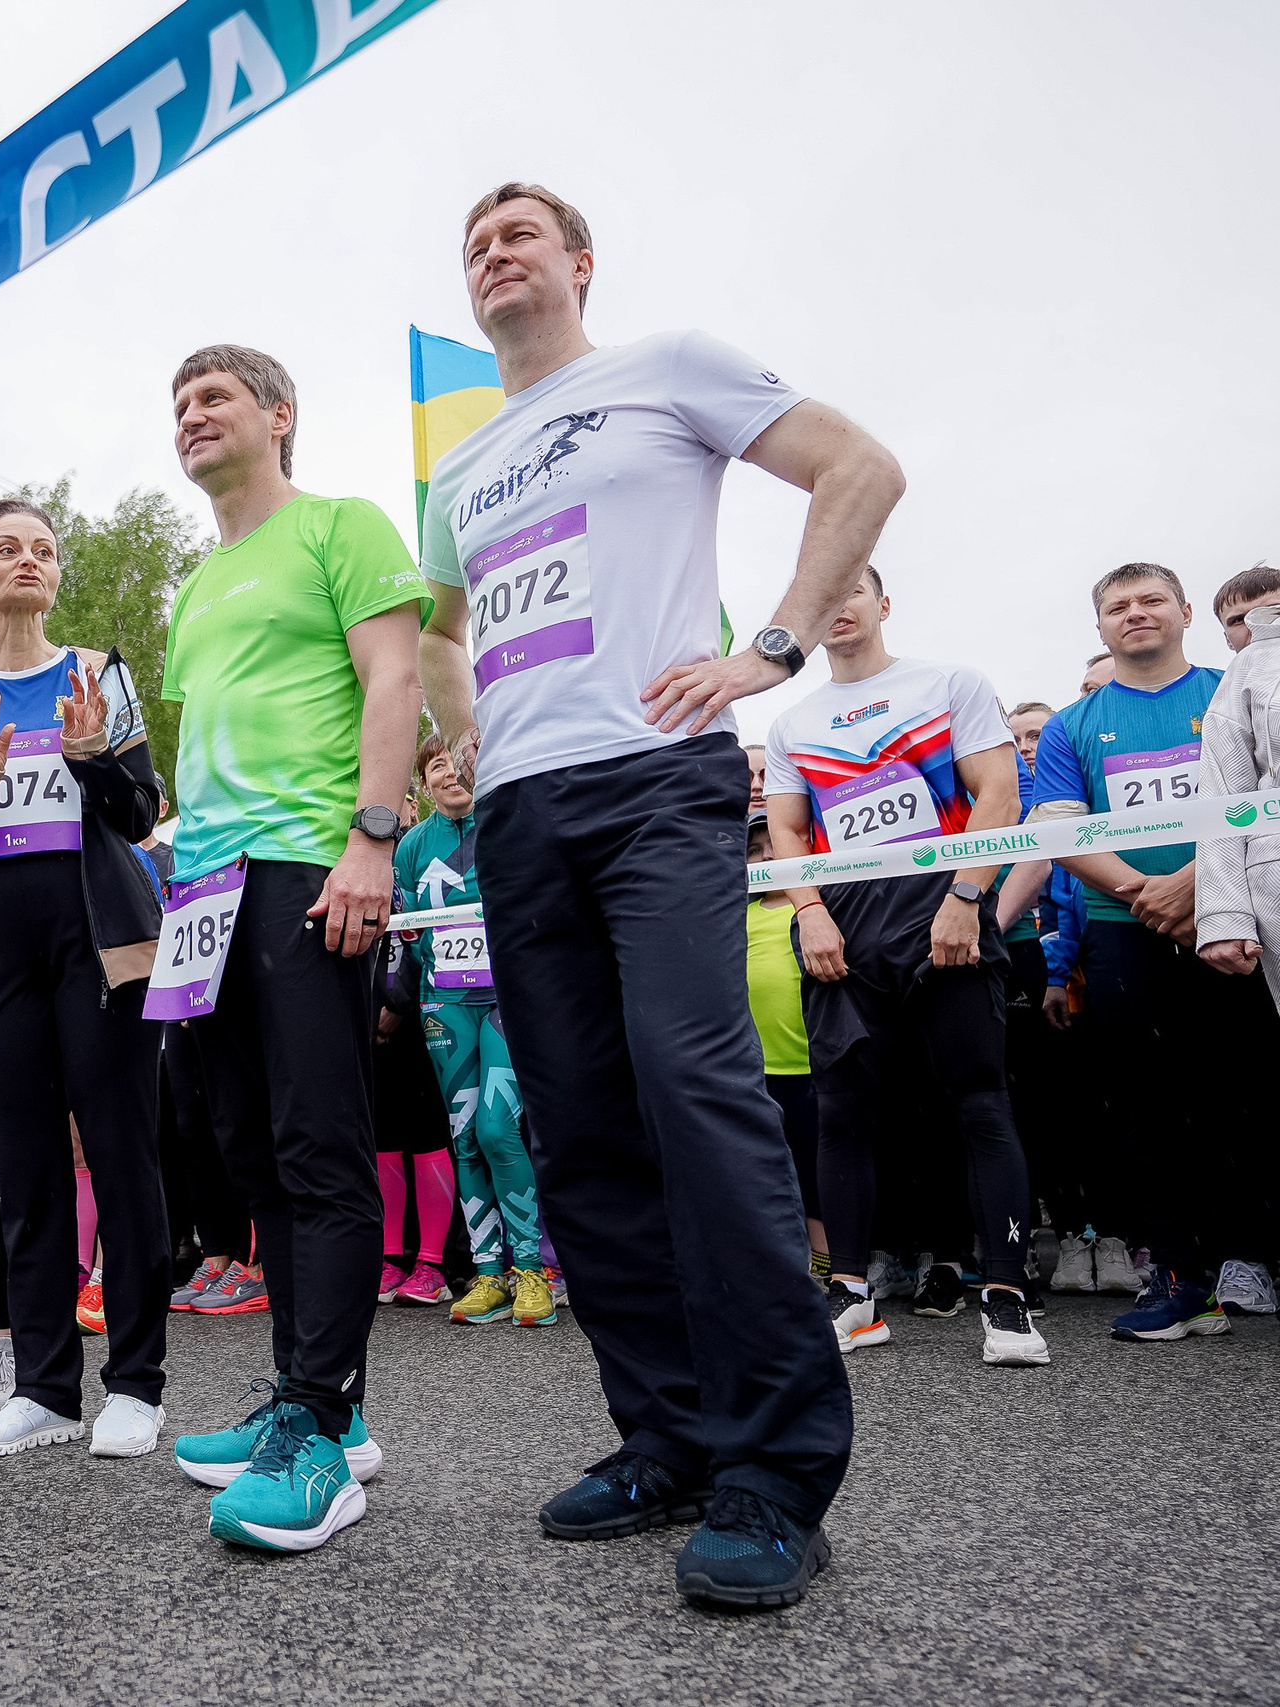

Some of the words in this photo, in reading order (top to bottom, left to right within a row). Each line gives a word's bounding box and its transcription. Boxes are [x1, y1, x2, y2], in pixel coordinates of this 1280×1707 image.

[459, 462, 531, 532] Utair
[476, 560, 570, 639] 2072
[1124, 773, 1199, 808] 215
[839, 792, 918, 842] 2289
[1104, 825, 1141, 838] ЗЕЛЕНЫЙ
[1143, 821, 1184, 832] МАРАФОН
[822, 863, 852, 874] ЗЕЛЕНЫЙ
[853, 860, 883, 870] МАРАФОН
[941, 833, 1039, 858] СБЕРБАНК
[172, 909, 234, 967] 2185
[441, 937, 485, 960] 229
